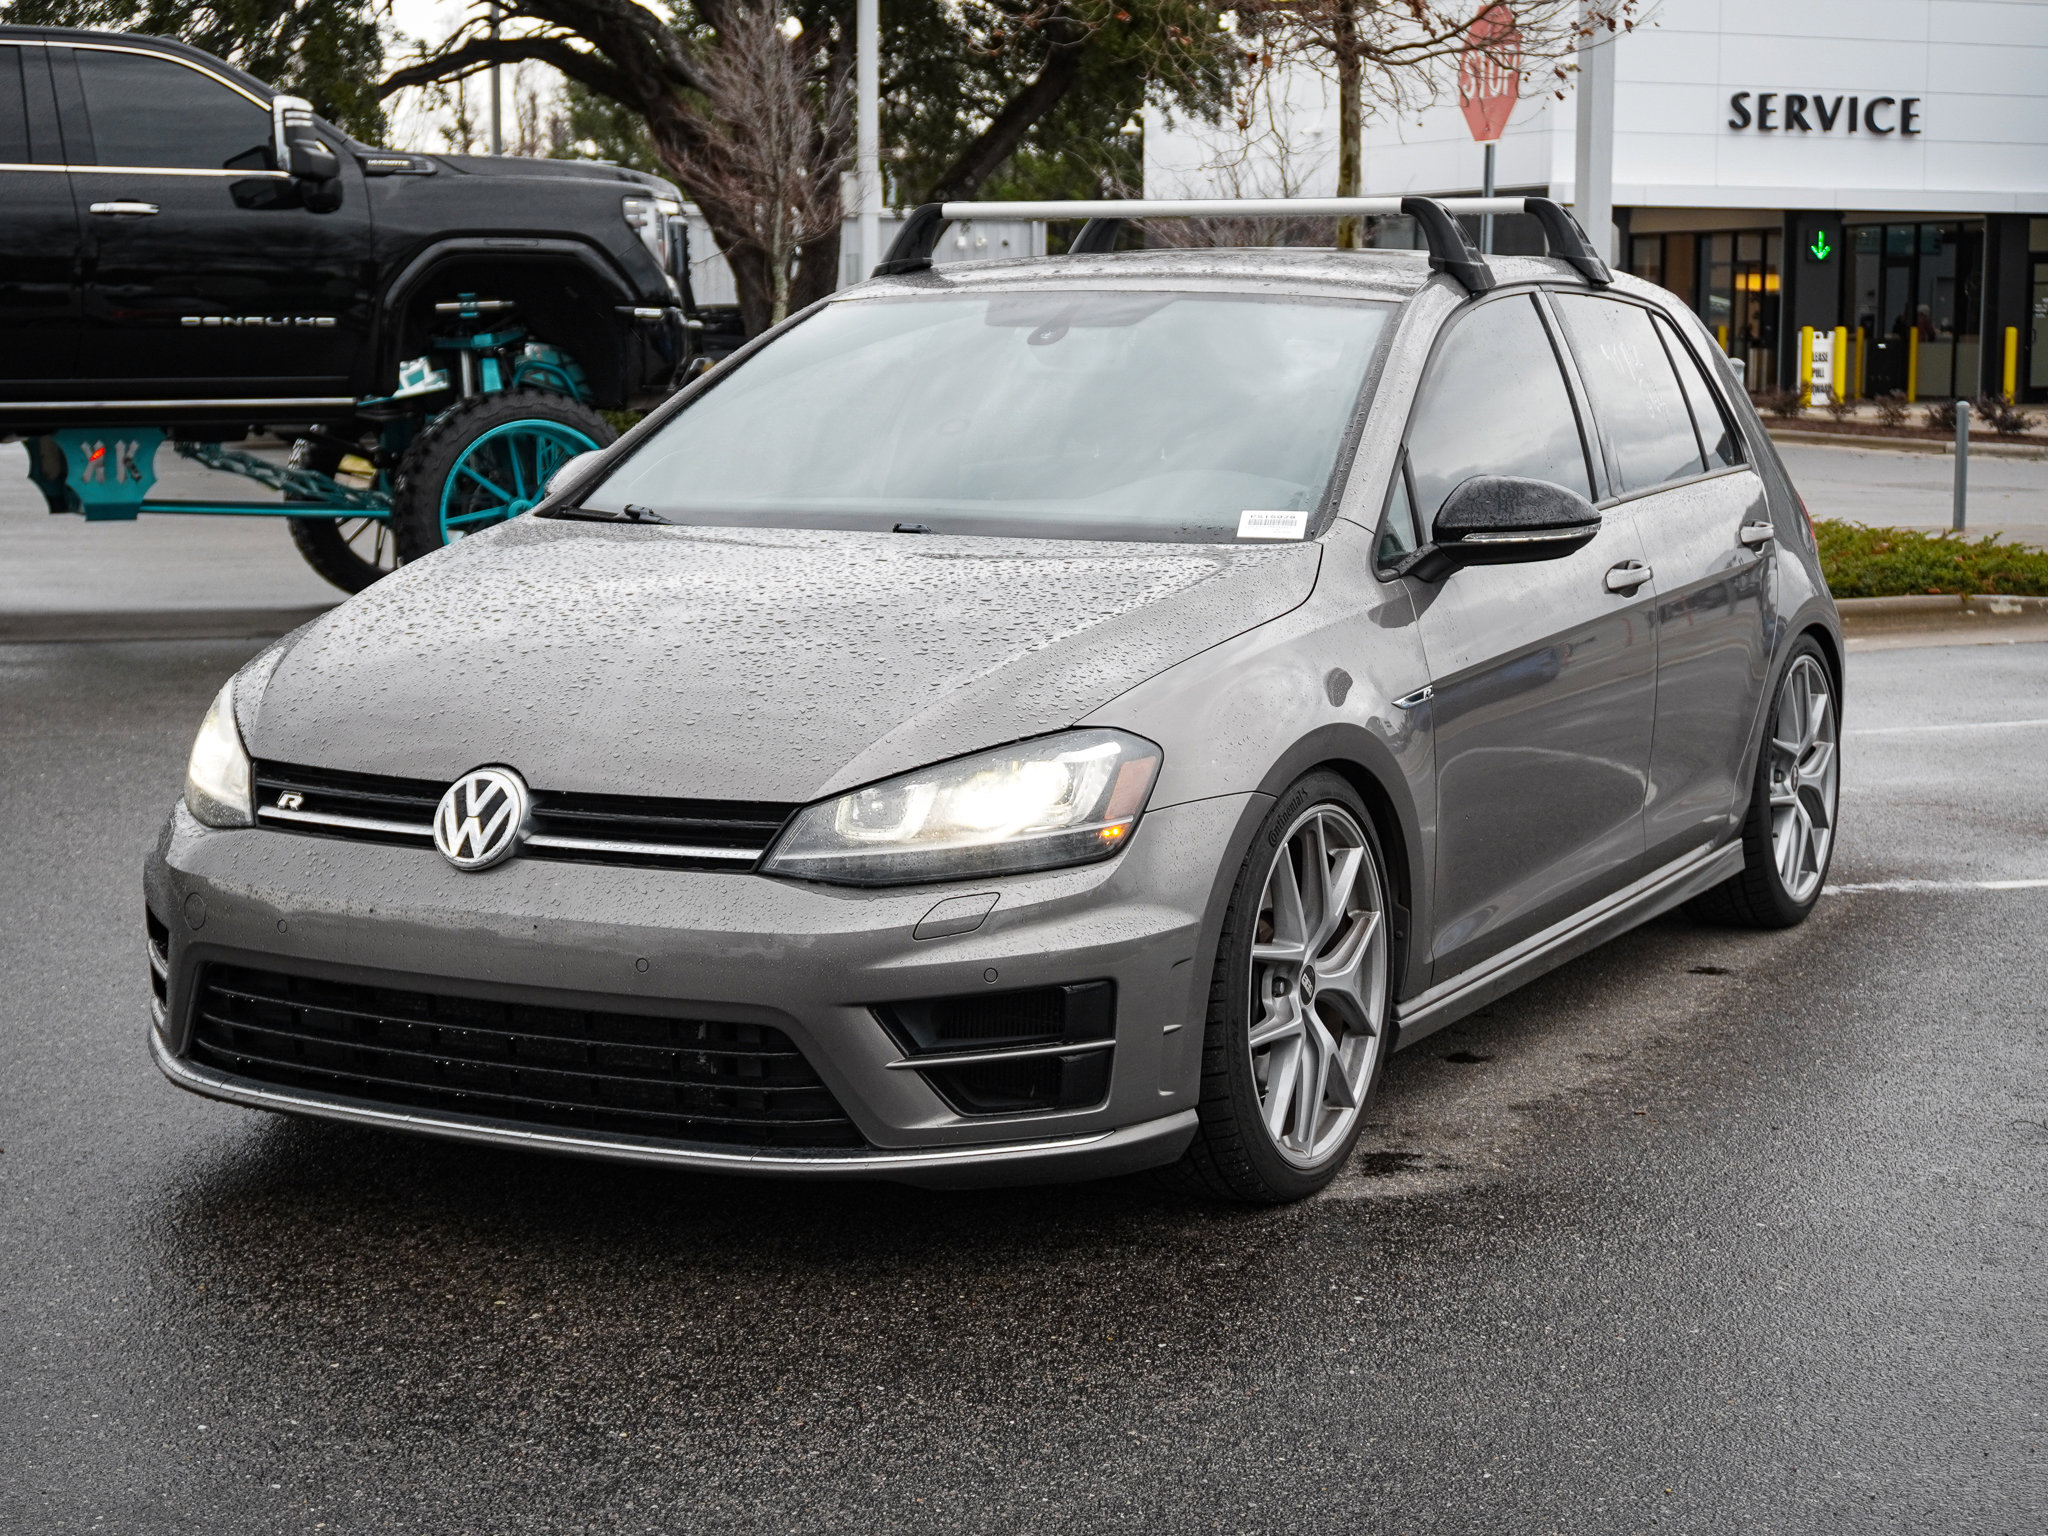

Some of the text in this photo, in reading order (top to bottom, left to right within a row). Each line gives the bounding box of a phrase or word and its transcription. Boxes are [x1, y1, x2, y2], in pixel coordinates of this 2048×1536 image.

[1462, 44, 1519, 99] STOP
[1728, 91, 1922, 135] SERVICE
[277, 790, 304, 811] R
[1268, 789, 1304, 847] Continental
